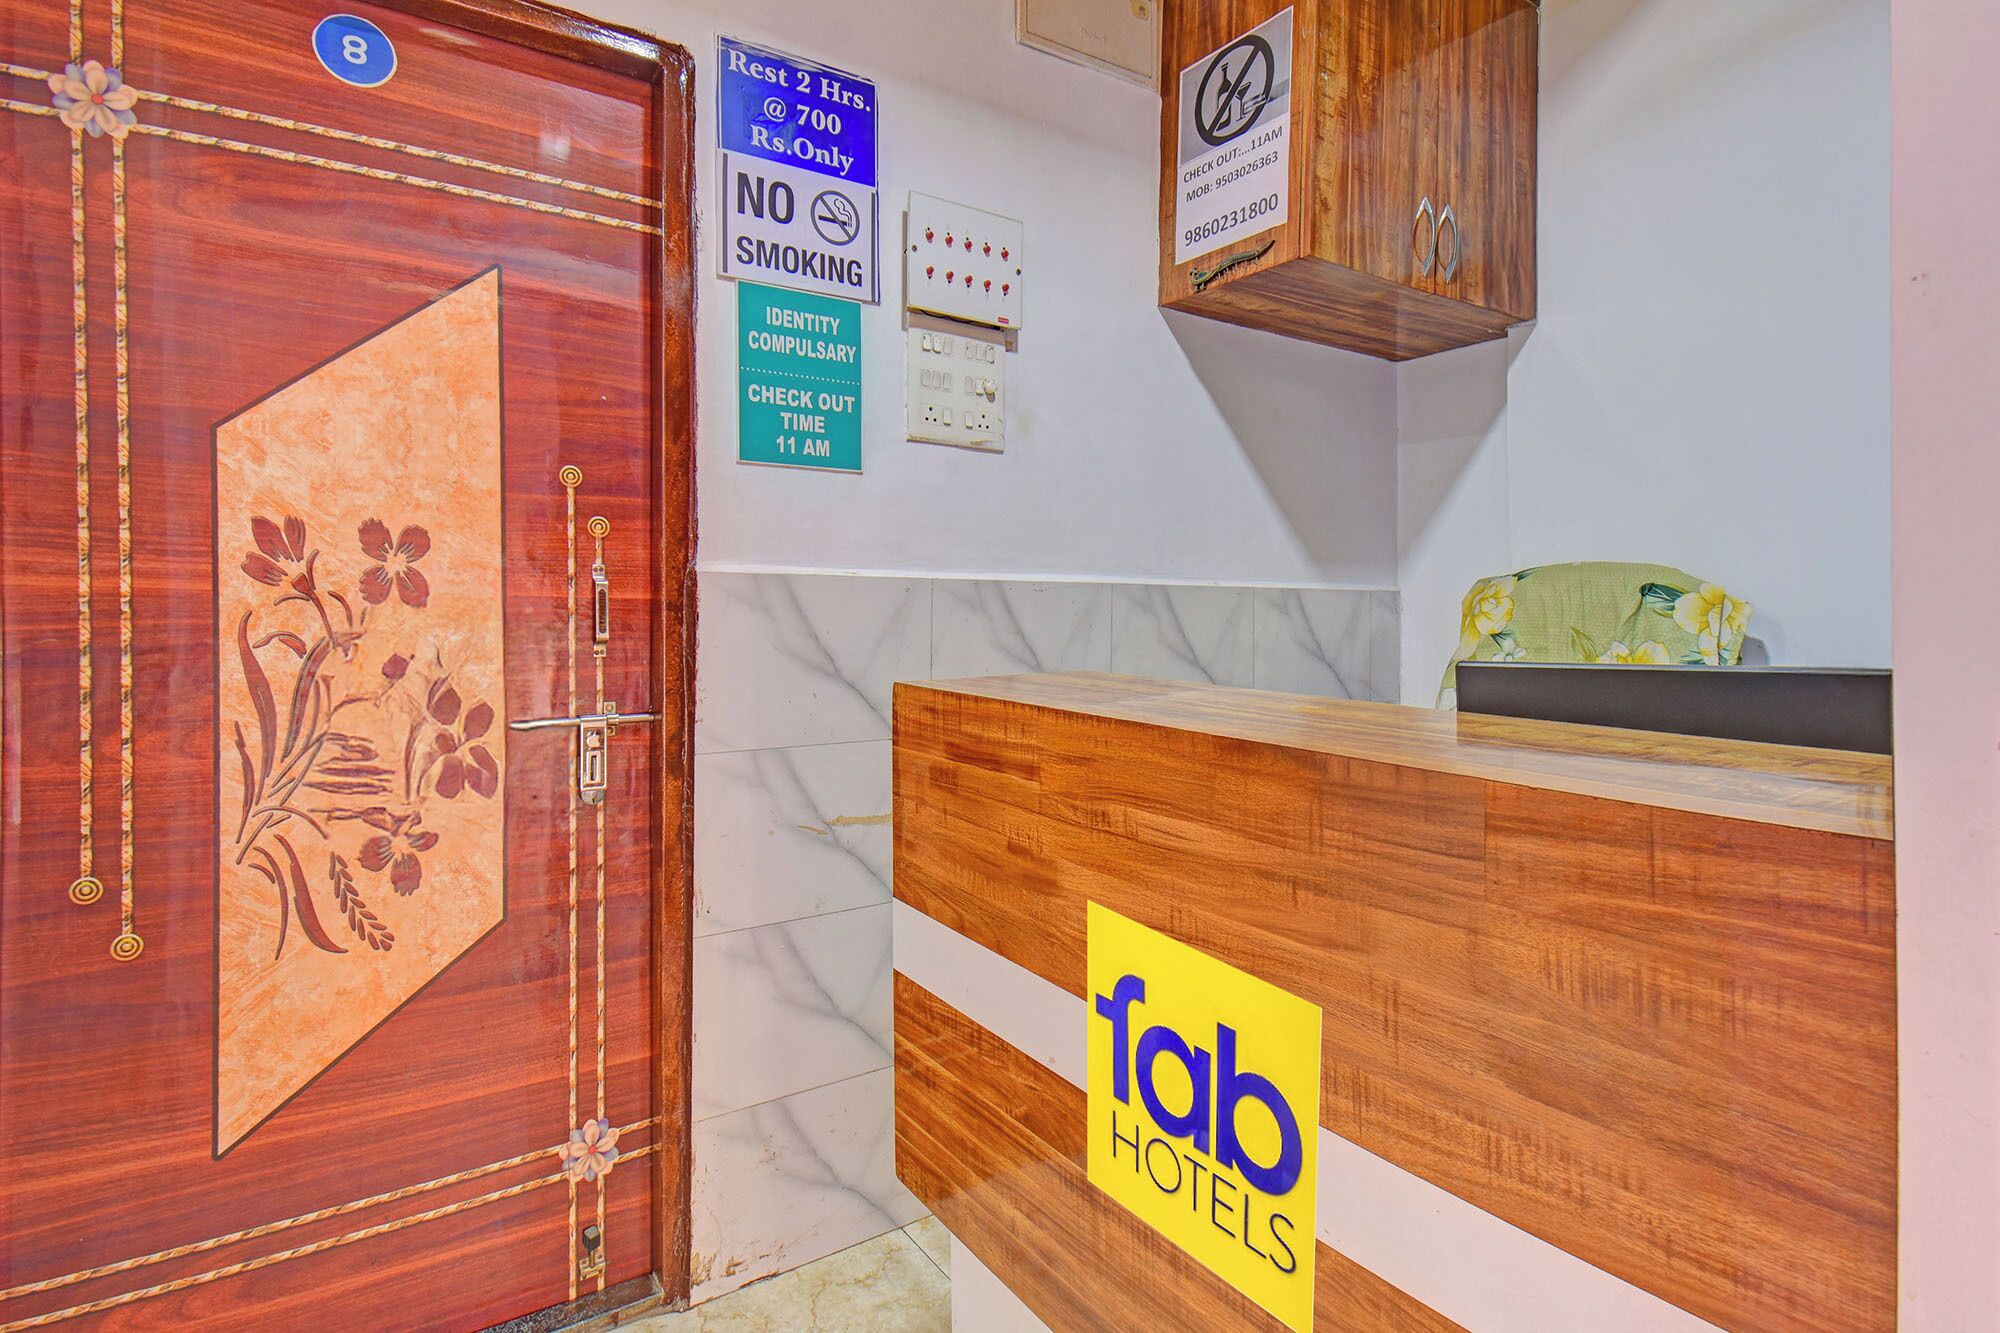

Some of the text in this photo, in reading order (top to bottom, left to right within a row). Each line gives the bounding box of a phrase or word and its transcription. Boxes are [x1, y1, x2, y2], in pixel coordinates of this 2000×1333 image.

[342, 34, 368, 65] 8
[728, 48, 871, 112] Rest 2 Hrs.
[763, 97, 842, 135] @ 700
[750, 124, 854, 176] Rs.Only
[1183, 159, 1214, 184] CHECK
[737, 171, 795, 225] NO
[1186, 151, 1278, 203] MOB: 9503026363
[1184, 193, 1279, 247] 9860231800
[736, 235, 863, 288] SMOKING
[766, 306, 840, 336] IDENTITY
[748, 330, 857, 364] COMPULSARY
[747, 383, 856, 413] CHECK OUT
[780, 412, 826, 434] TIME
[776, 435, 831, 457] 11 AM
[1095, 973, 1304, 1196] fab
[1112, 1110, 1297, 1274] HOTELS
